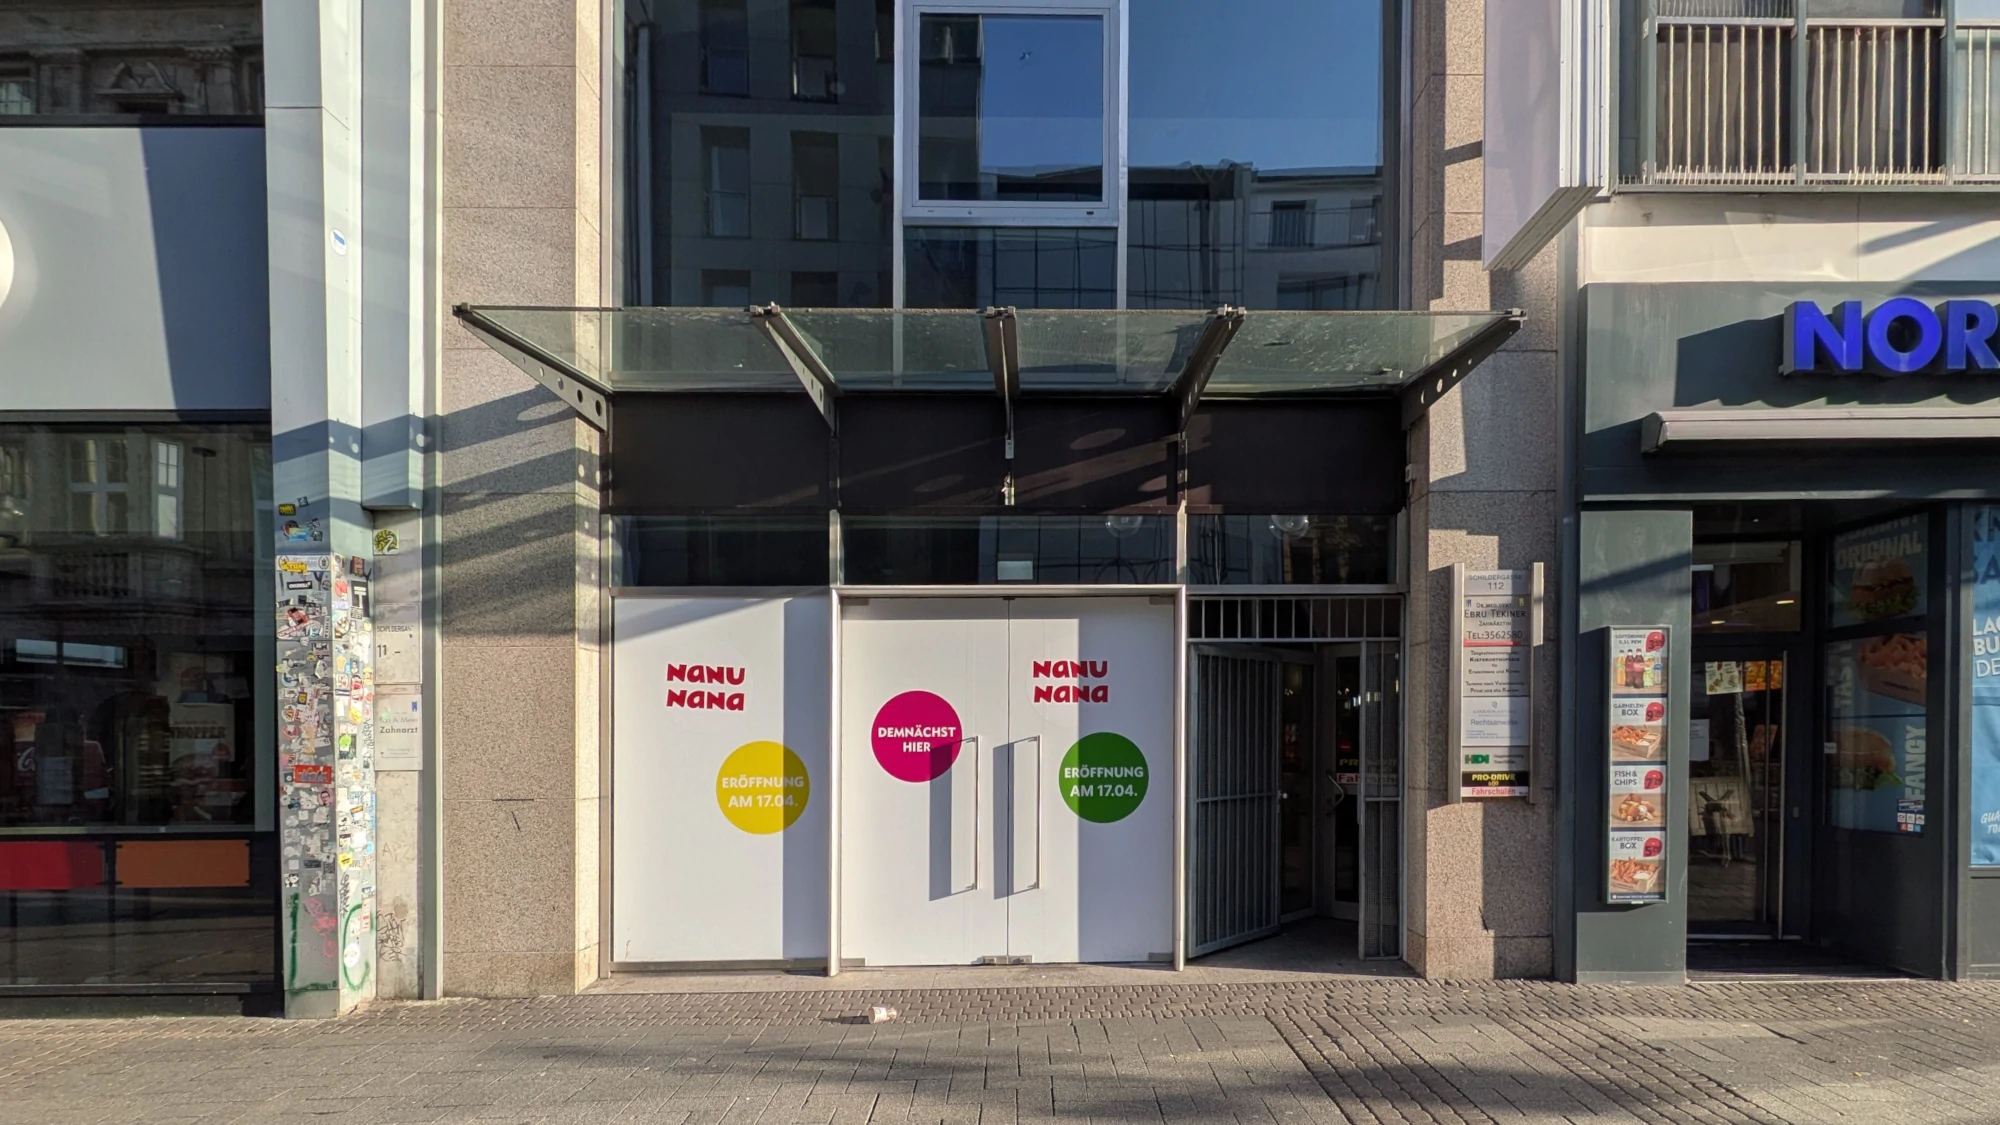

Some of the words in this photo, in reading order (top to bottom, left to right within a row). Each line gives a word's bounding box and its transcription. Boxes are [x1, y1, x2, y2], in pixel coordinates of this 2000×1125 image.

[1793, 297, 2000, 373] NOR
[1835, 531, 1922, 571] ORIGINAL
[1488, 582, 1504, 590] 112
[1464, 609, 1487, 618] EBRU
[1491, 609, 1526, 618] TEKINER
[1467, 630, 1523, 640] TEL:3562580
[380, 726, 418, 734] Zahnarzt
[878, 724, 956, 738] DEMNÄCHST
[903, 741, 931, 752] HIER
[1465, 754, 1490, 764] HDI
[1904, 724, 1926, 800] FANCY
[1064, 764, 1144, 778] ERÖFFNUNG
[722, 774, 804, 789] ERÖFFNUNG
[1070, 785, 1093, 797] AM
[1096, 784, 1138, 797] 17.04.
[1472, 787, 1516, 795] Fahrschulen
[728, 795, 753, 808] AM
[756, 794, 799, 808] 17.04.
